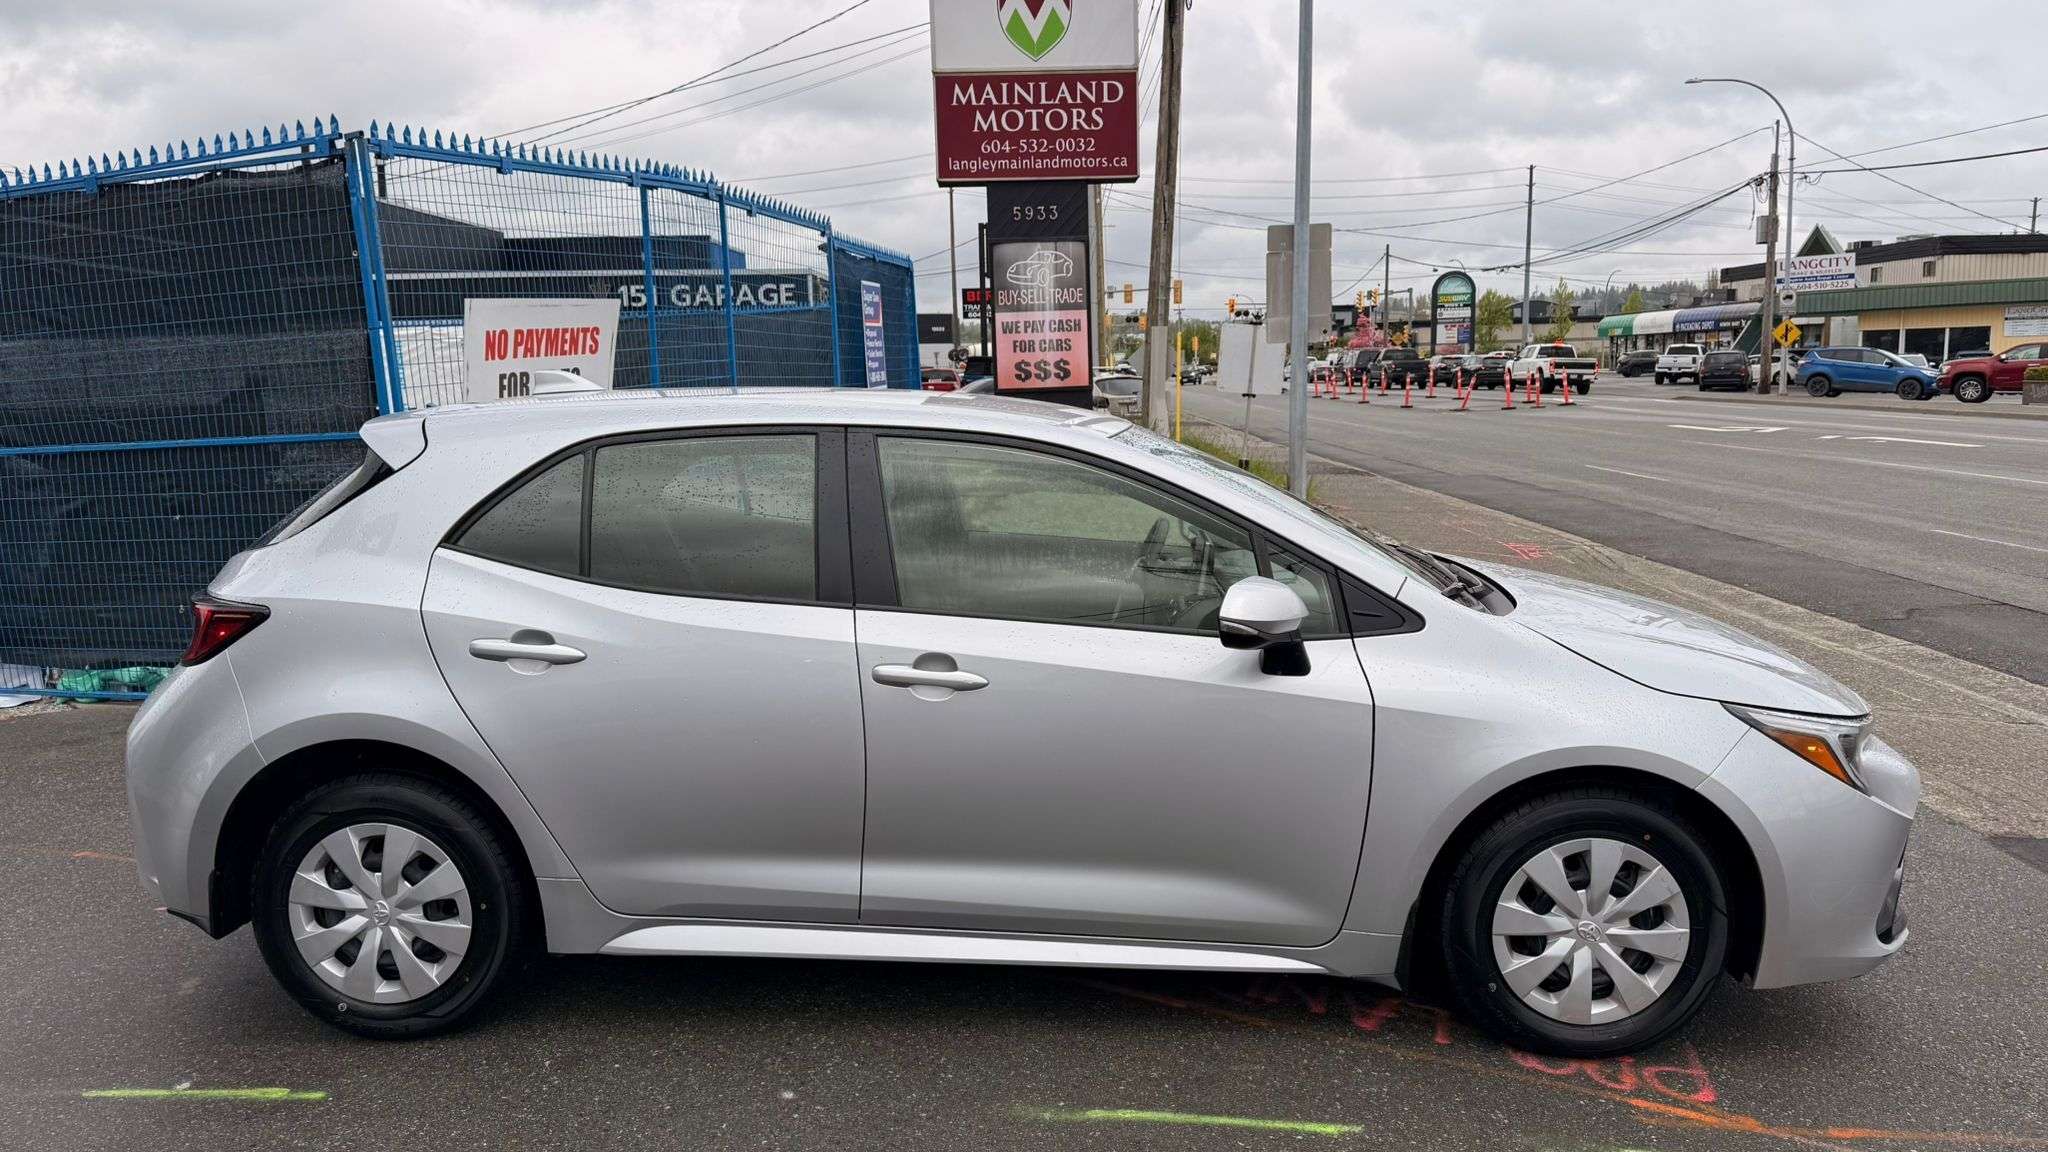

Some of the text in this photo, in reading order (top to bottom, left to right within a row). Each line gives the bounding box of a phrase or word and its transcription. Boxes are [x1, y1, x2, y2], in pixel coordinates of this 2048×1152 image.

[950, 80, 1124, 106] MAINLAND
[972, 108, 1104, 132] MOTORS
[981, 138, 1096, 154] 604-532-0032
[948, 155, 1128, 173] langleymainlandmotors.ca
[1013, 205, 1059, 221] 5933
[670, 283, 796, 307] GARAGE
[1001, 319, 1082, 334] WE PAY CASH
[484, 326, 600, 362] NO PAYMENTS
[1012, 338, 1072, 353] FOR CARS
[1014, 358, 1072, 383] $$$
[498, 371, 530, 399] FOR
